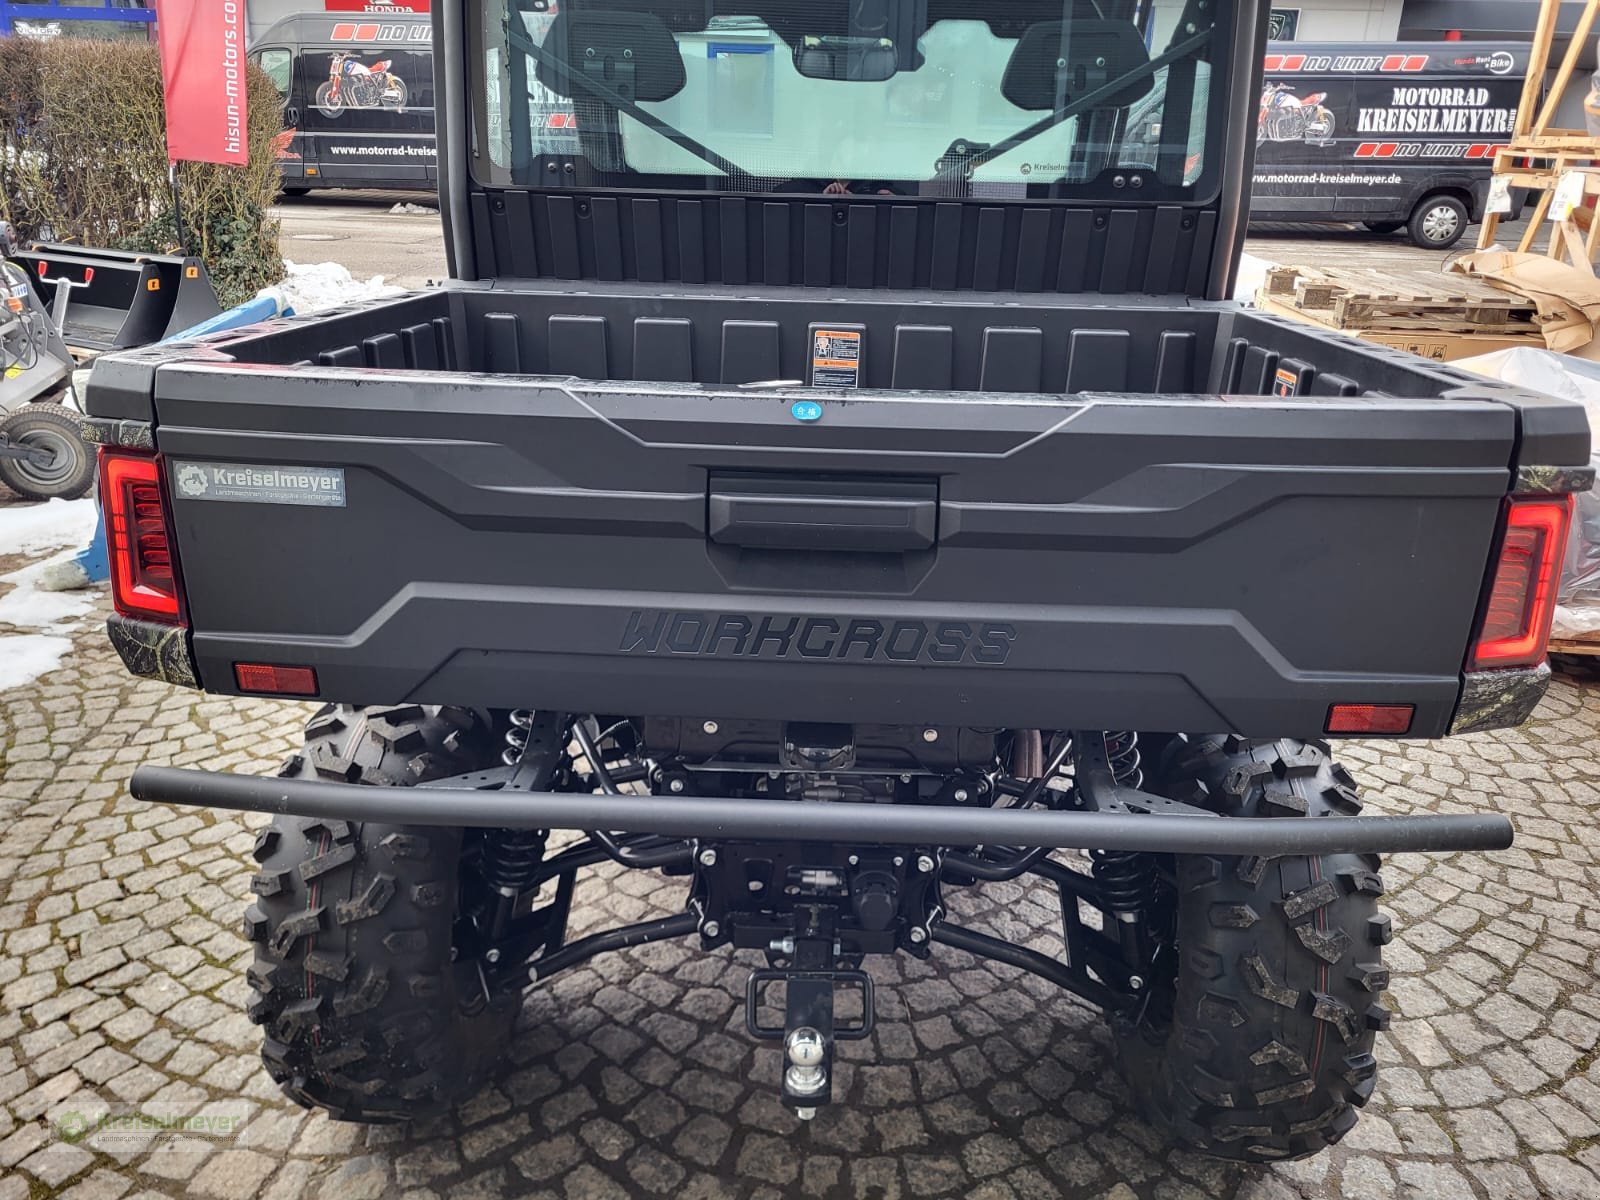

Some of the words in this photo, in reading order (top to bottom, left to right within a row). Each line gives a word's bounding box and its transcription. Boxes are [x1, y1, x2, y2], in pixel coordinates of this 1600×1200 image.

[363, 5, 415, 13] HONDA
[1303, 56, 1331, 71] NO
[1330, 56, 1384, 71] LIMIT
[1476, 56, 1491, 64] Rent
[1490, 59, 1511, 69] Bike
[222, 0, 240, 153] hisun-motors.co
[1391, 88, 1489, 106] MOTORRAD
[1356, 108, 1508, 133] KREISELMEYER
[1393, 143, 1422, 157] NO
[1420, 144, 1470, 157] LIMIT
[213, 468, 340, 492] Kreiselmeyer
[619, 611, 1018, 664] WORKCROSS
